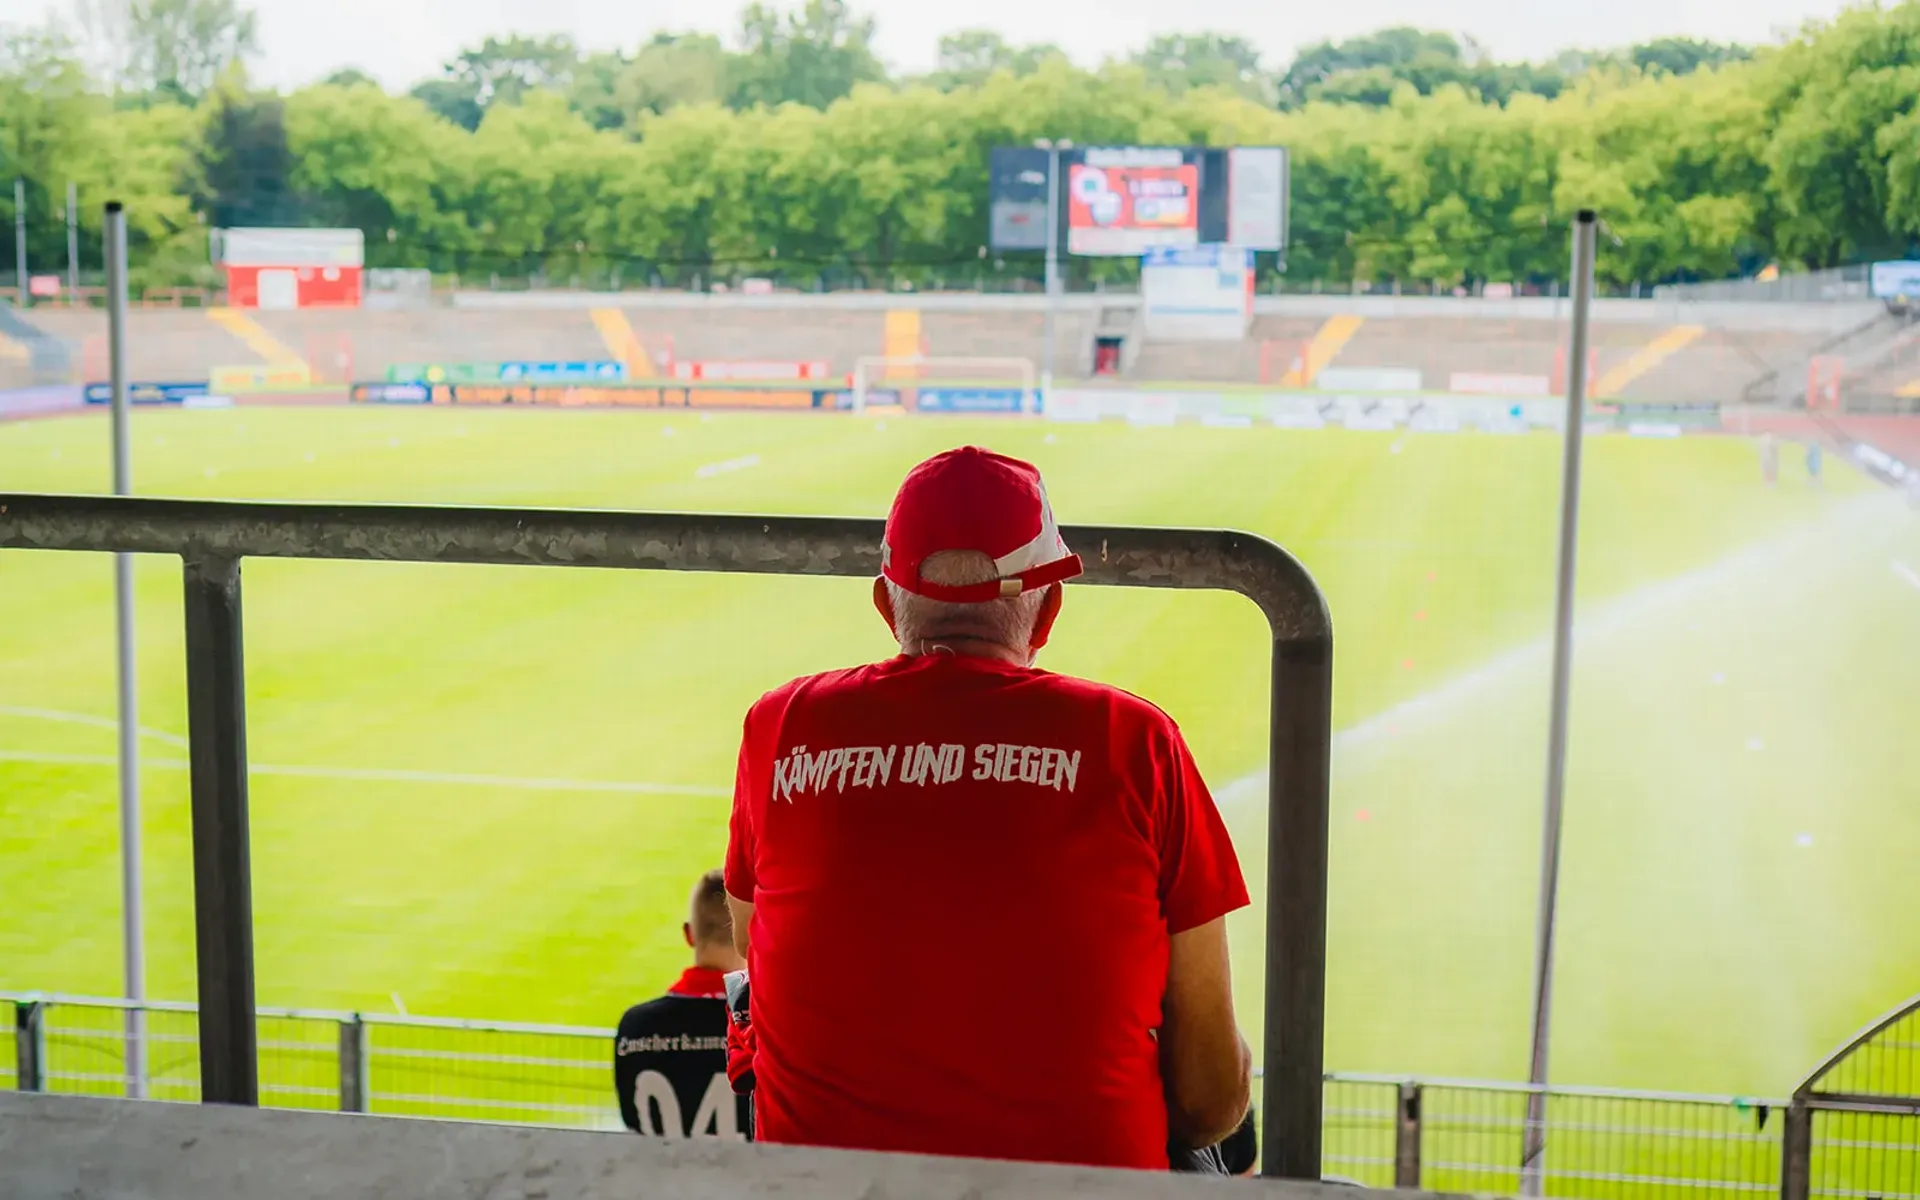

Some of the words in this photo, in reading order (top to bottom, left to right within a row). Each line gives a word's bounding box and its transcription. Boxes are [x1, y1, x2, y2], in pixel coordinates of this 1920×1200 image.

[772, 745, 896, 804] KÄMPFEN
[900, 742, 964, 786] UND
[972, 743, 1081, 792] SIEGEN
[634, 1070, 745, 1140] 04
